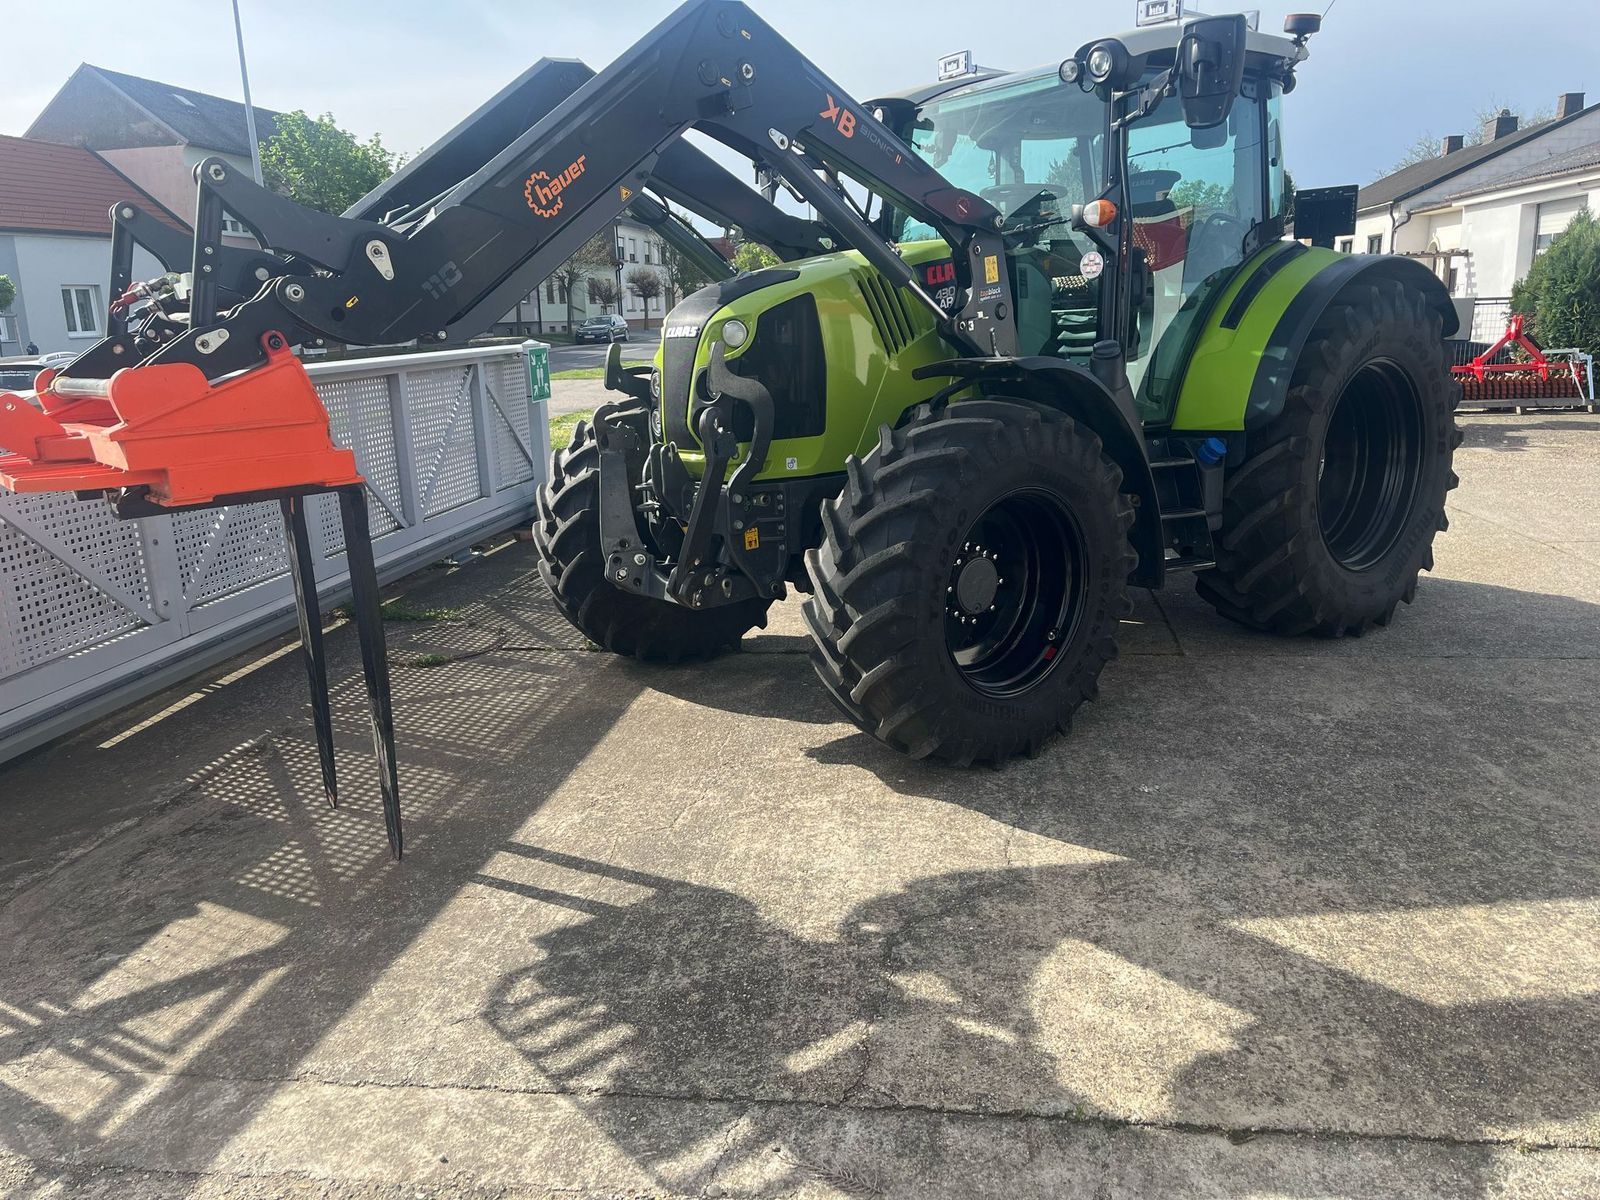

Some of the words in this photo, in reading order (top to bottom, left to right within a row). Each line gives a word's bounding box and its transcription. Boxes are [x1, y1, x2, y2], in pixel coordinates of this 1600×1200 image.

[819, 93, 856, 138] XB
[860, 123, 894, 155] BIONIC
[534, 154, 586, 206] hauer
[421, 260, 463, 300] 110
[927, 262, 955, 285] CLA
[935, 286, 956, 299] 430
[666, 325, 699, 338] CLAAS
